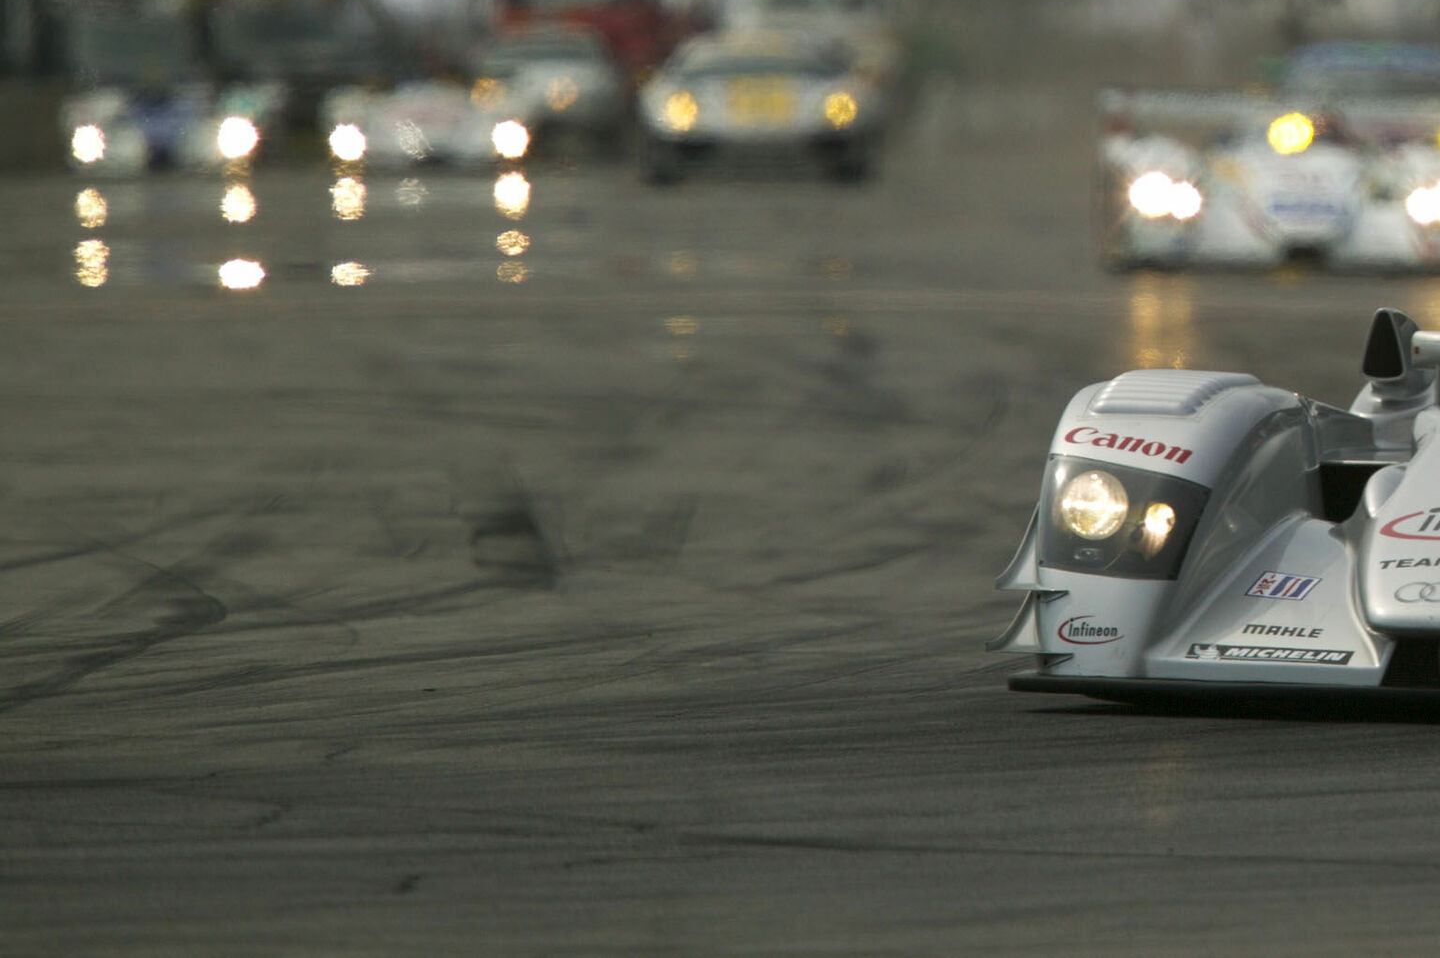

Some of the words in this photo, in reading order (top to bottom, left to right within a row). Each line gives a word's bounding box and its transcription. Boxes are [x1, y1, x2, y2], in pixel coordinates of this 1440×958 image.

[1065, 426, 1193, 465] Canon
[1242, 624, 1324, 639] MAHLE
[1223, 646, 1347, 661] MICHELIN
